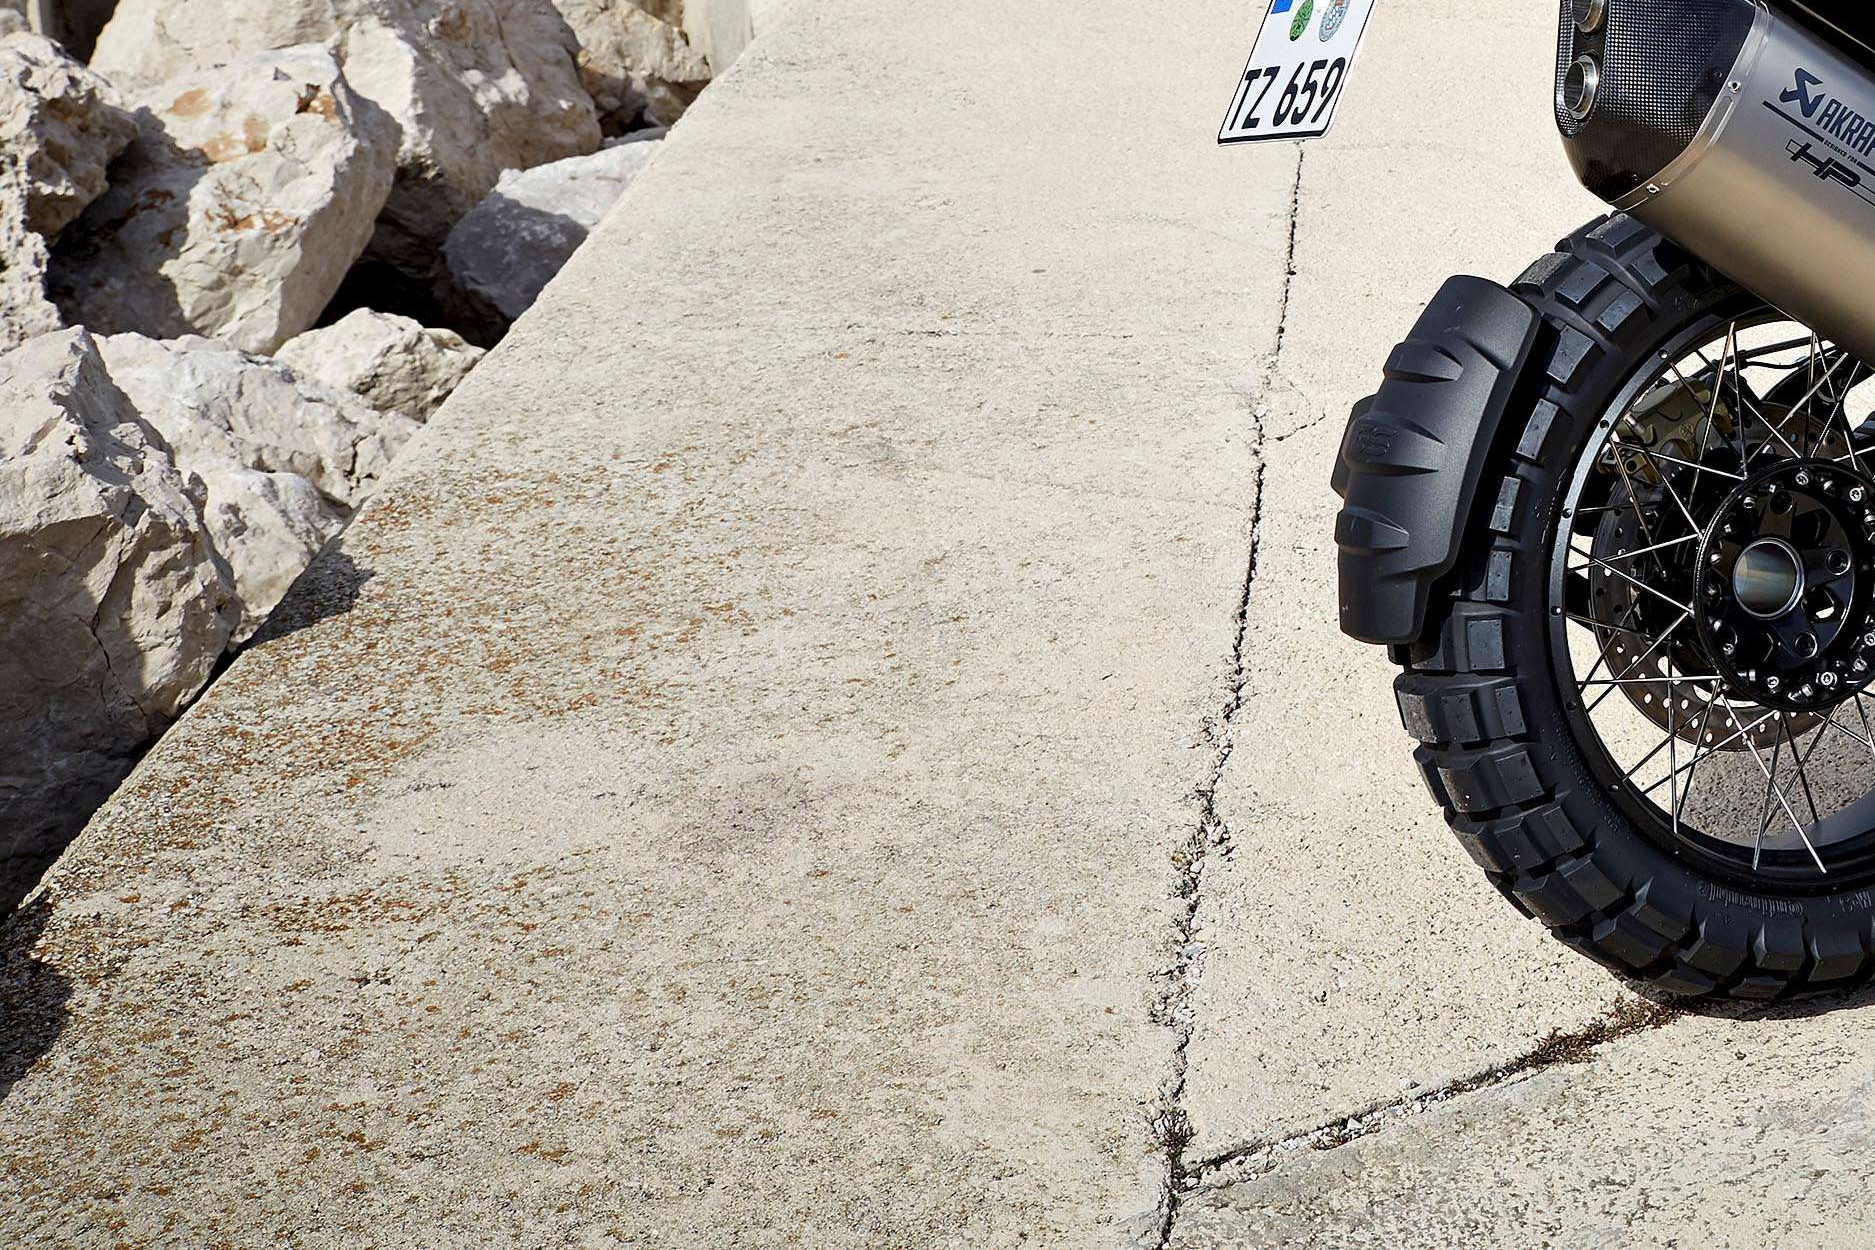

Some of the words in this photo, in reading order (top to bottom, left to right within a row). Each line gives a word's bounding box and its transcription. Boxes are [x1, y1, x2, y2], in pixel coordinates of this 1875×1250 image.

[1228, 65, 1281, 131] TZ
[1272, 56, 1346, 128] 659
[1789, 142, 1861, 188] HP
